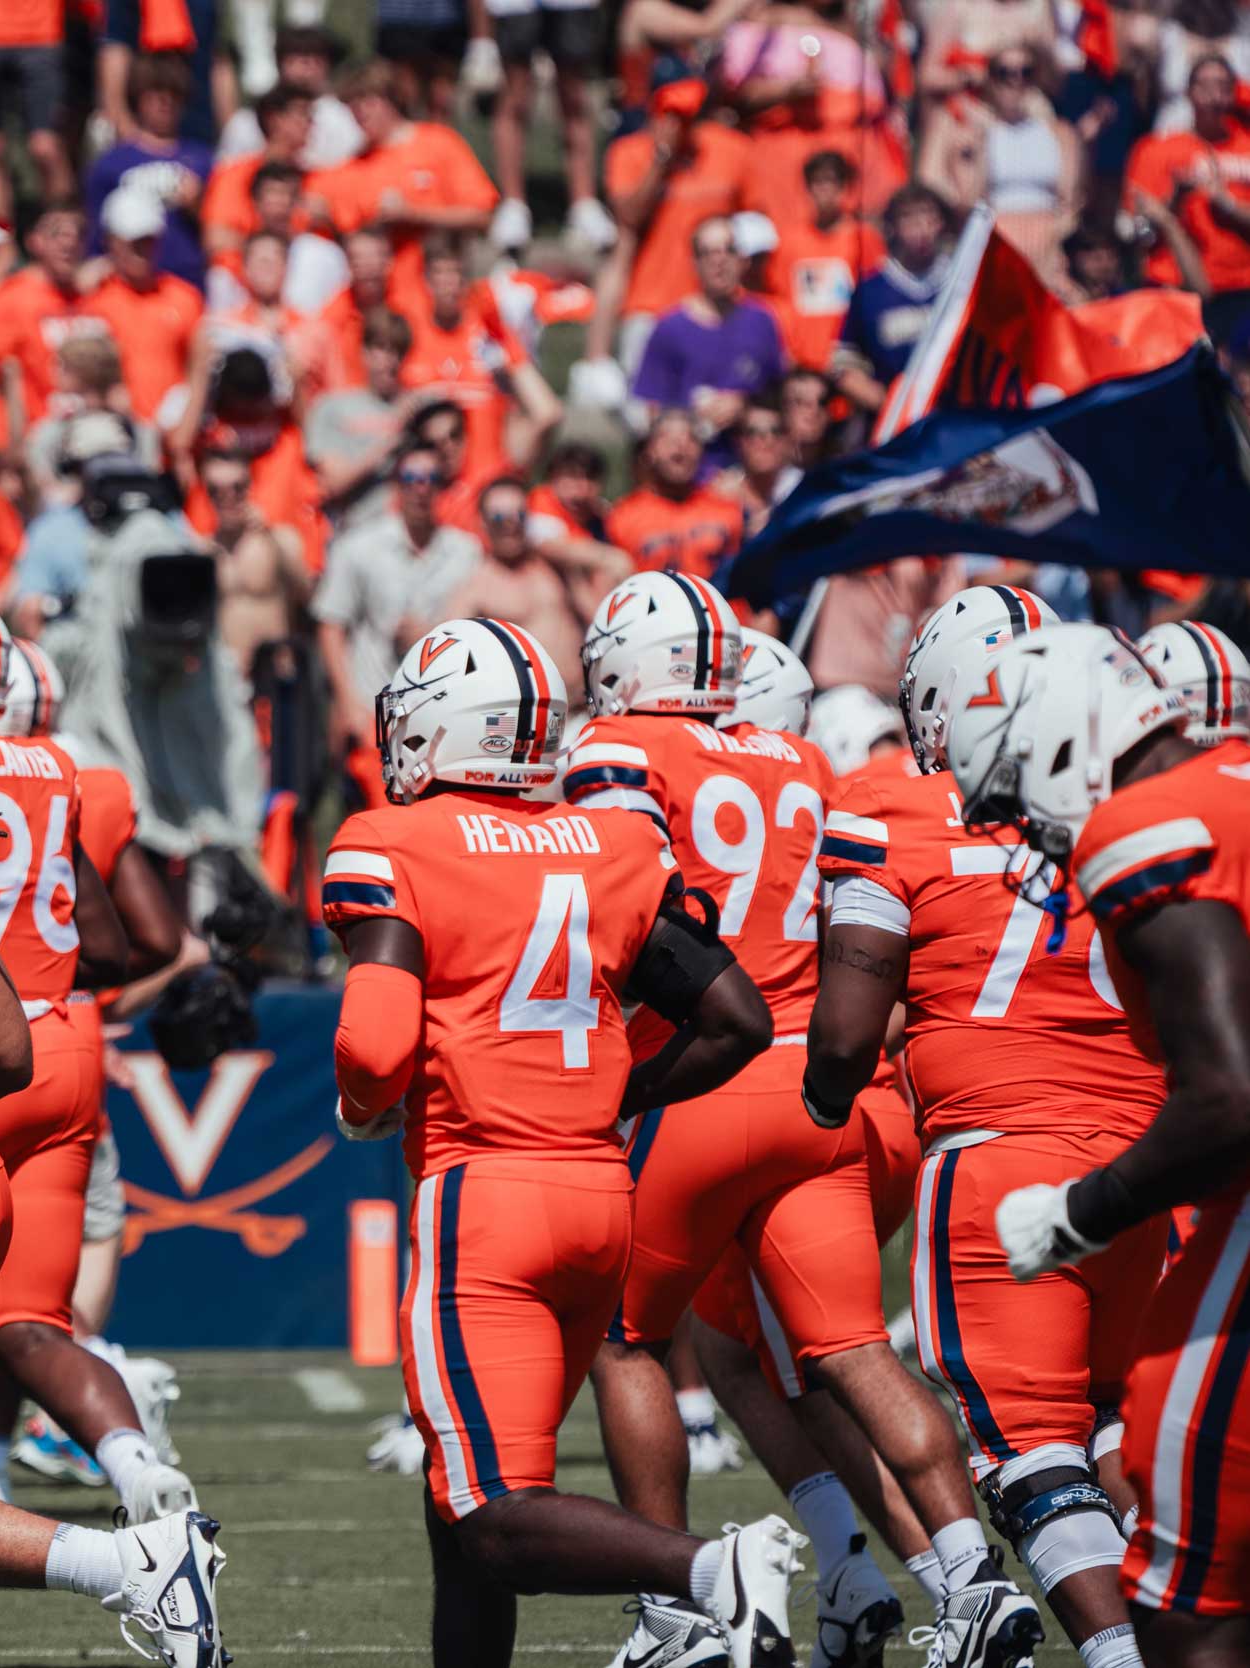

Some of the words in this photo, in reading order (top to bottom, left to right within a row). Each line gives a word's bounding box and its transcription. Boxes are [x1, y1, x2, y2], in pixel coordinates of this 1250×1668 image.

[456, 814, 601, 854] HERARD
[464, 769, 495, 783] FOR
[497, 772, 522, 783] ALL
[691, 774, 824, 942] 92
[500, 873, 601, 1069] 4
[950, 843, 1126, 1018] 7
